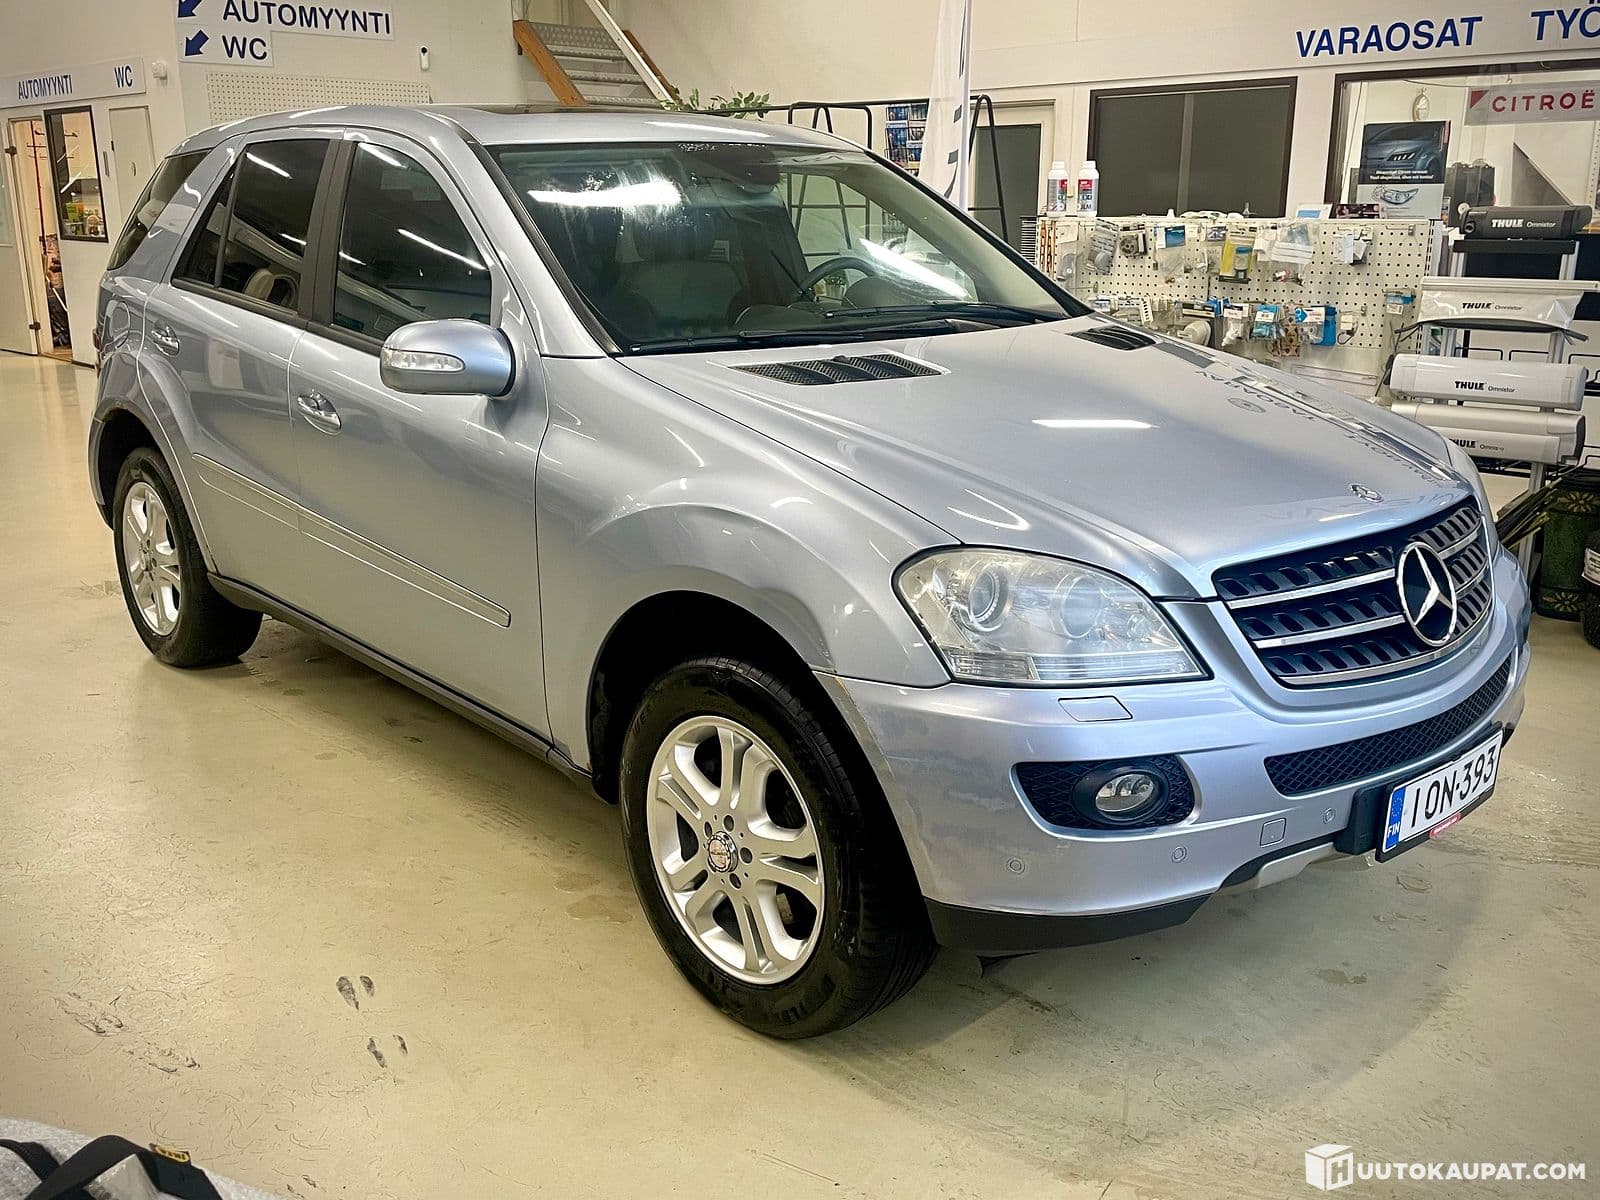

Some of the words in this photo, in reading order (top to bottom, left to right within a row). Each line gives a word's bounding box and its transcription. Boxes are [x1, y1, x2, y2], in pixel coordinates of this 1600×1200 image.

[223, 0, 391, 35] AUTOMYYNTI
[222, 35, 268, 60] WC
[1296, 16, 1483, 58] VARAOSAT
[18, 74, 72, 100] AUTOMYYNTI
[114, 66, 133, 89] WC
[1492, 90, 1595, 112] CITROË
[1492, 219, 1524, 228] THULE
[1454, 381, 1485, 390] THULE
[1450, 438, 1476, 448] HULE
[1411, 745, 1497, 828] ION-393
[1387, 822, 1400, 838] FIN
